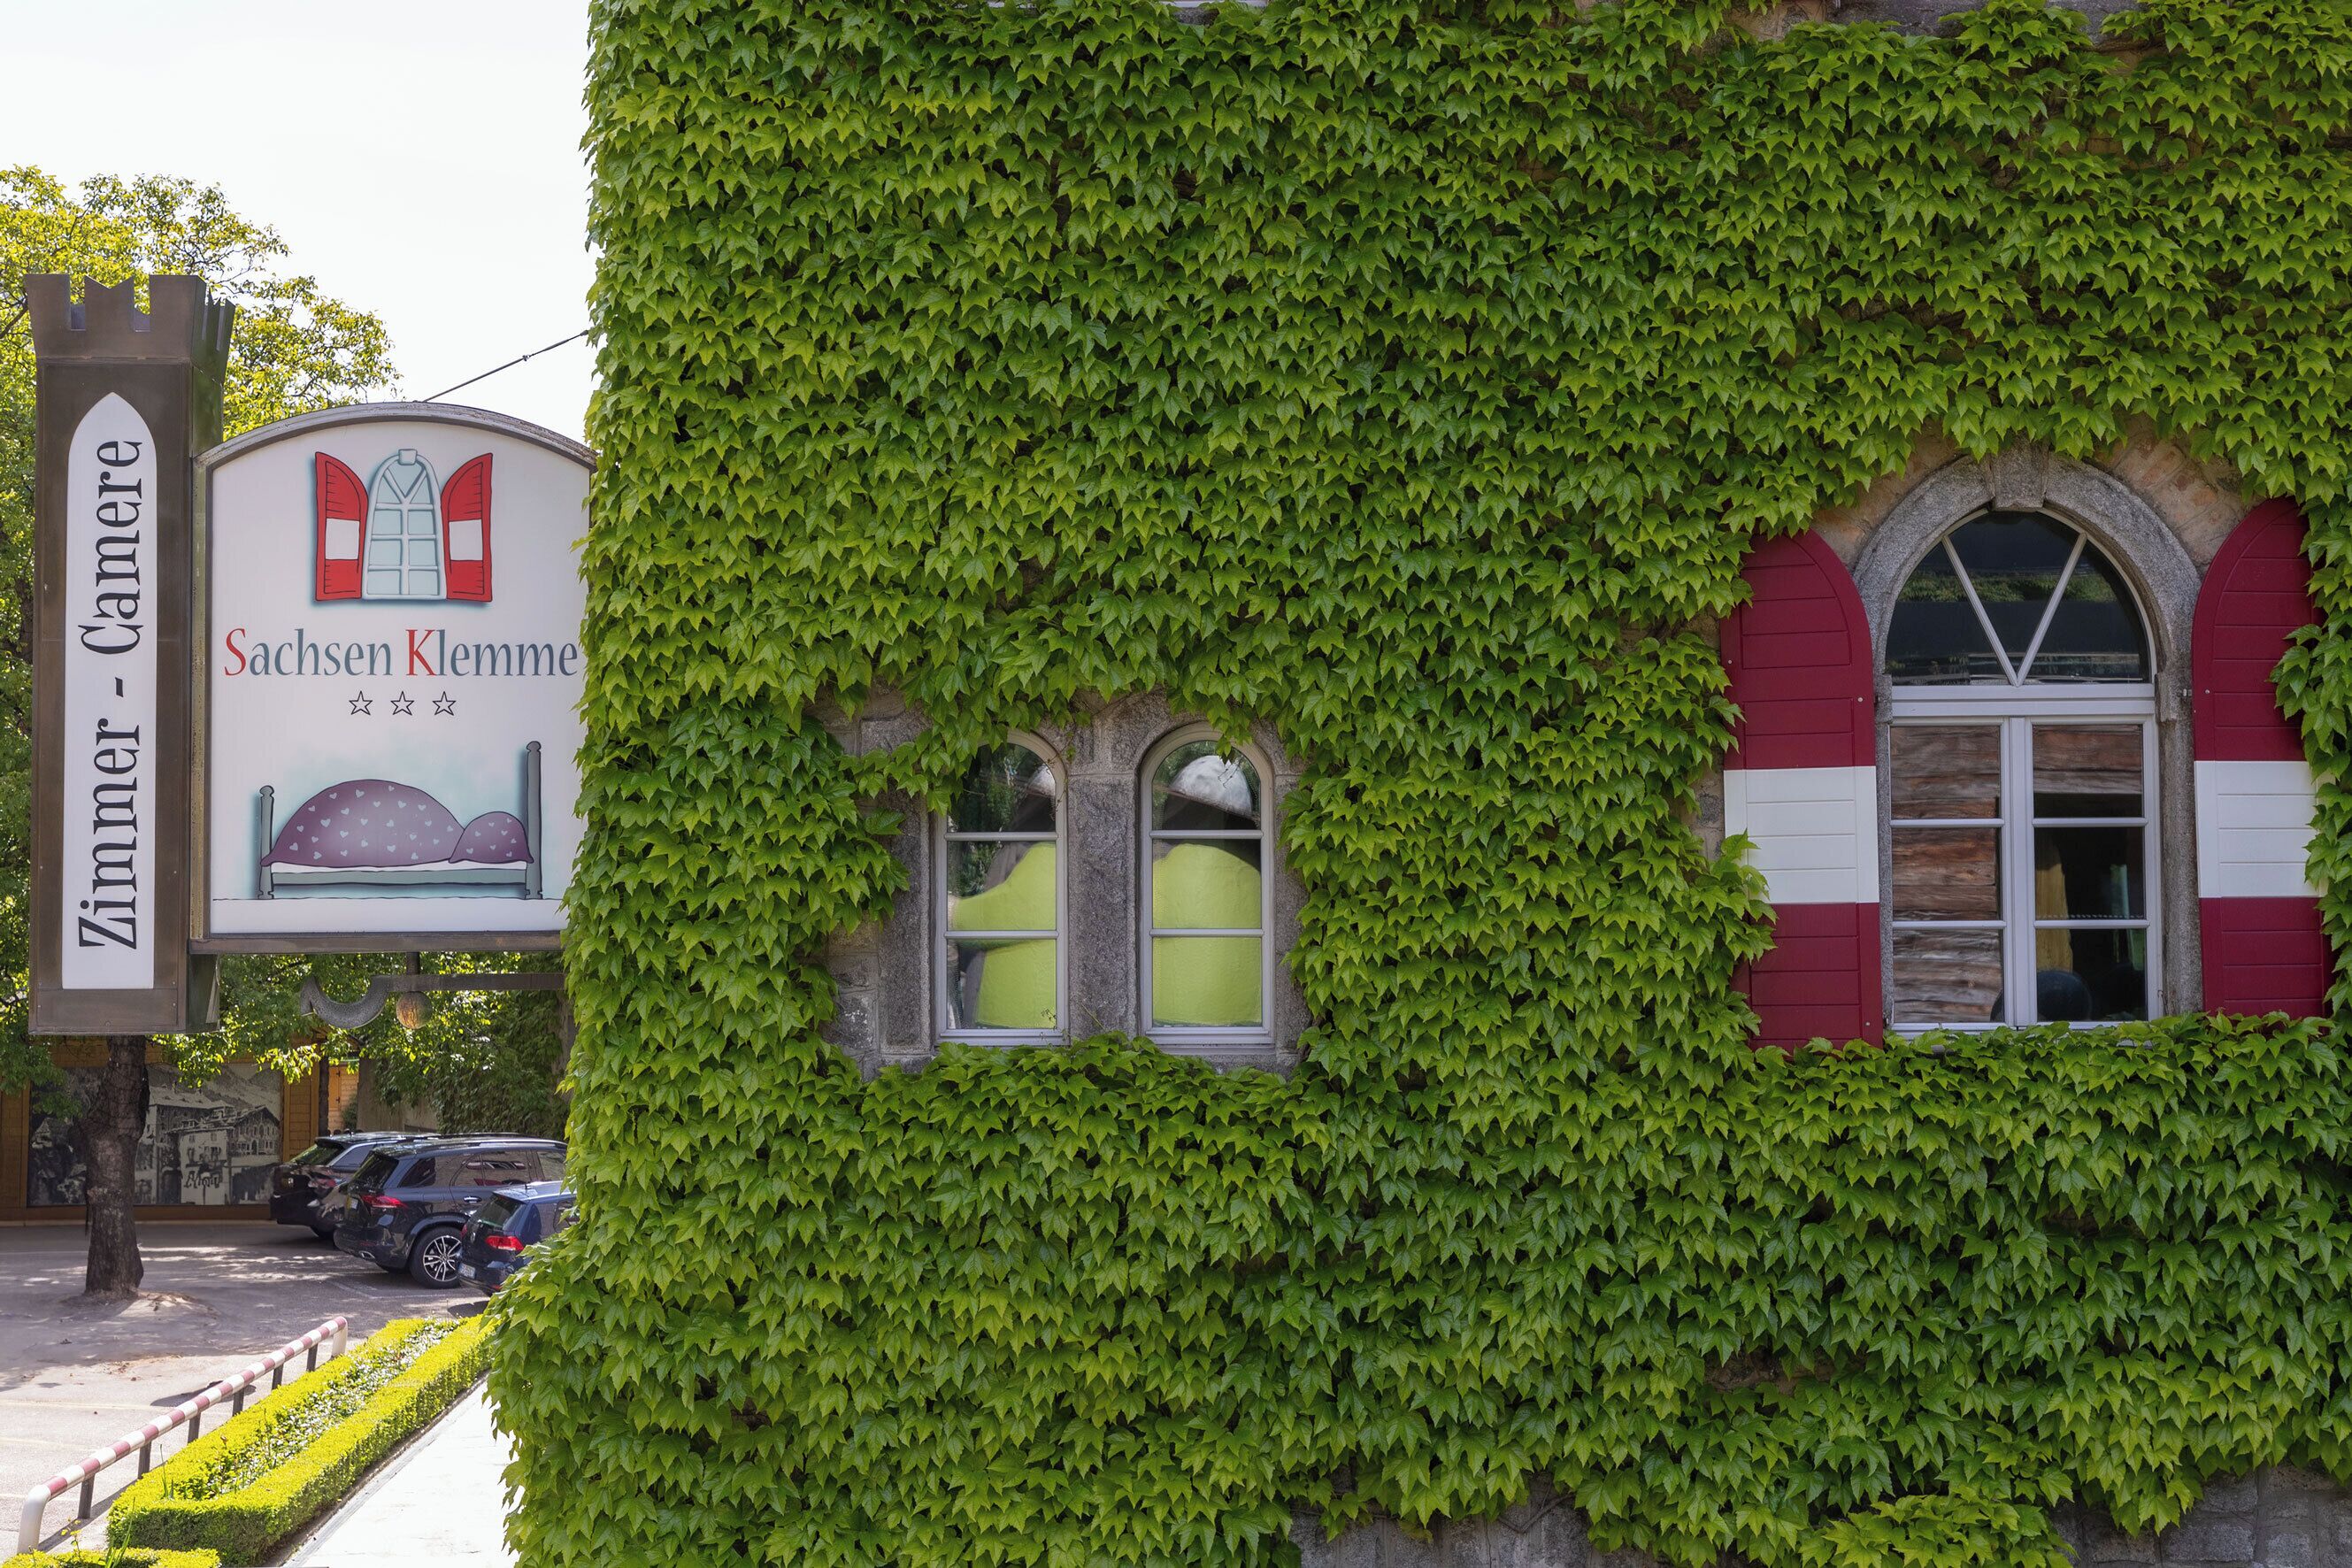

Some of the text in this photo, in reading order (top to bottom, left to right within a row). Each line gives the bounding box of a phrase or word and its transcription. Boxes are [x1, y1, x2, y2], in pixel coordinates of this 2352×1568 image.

[78, 440, 142, 655] Camere
[224, 627, 578, 677] Sachsen Klemme
[78, 718, 140, 950] Zimmer
